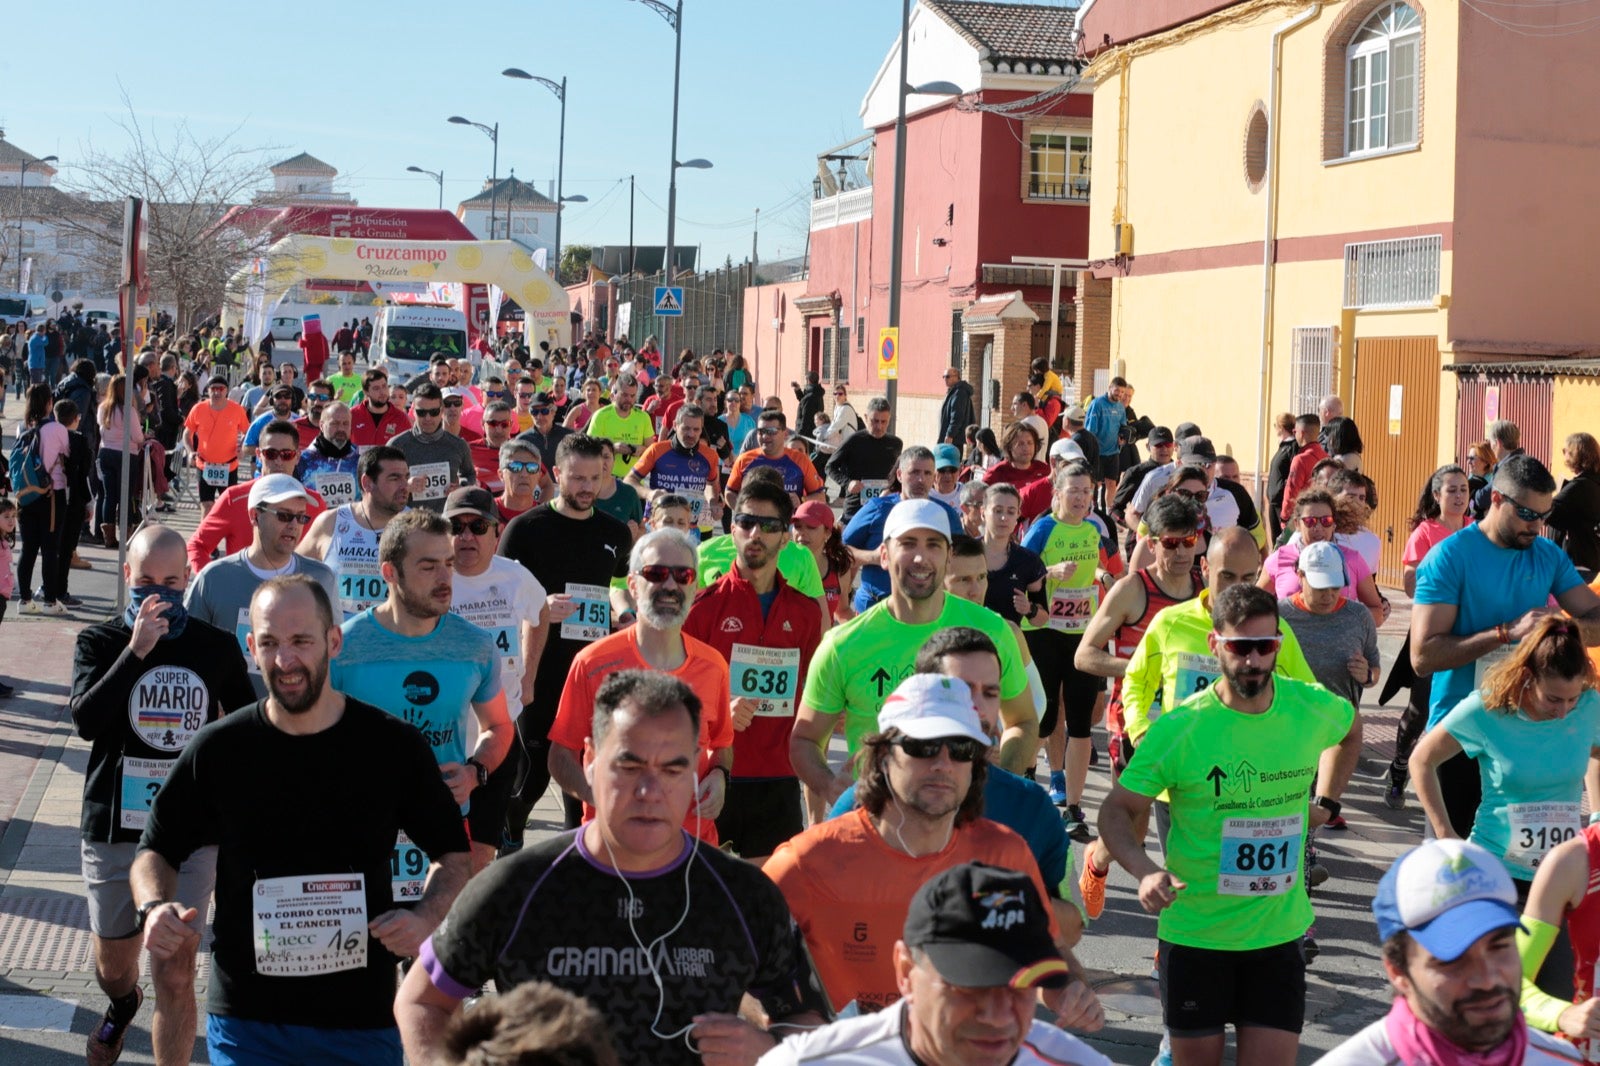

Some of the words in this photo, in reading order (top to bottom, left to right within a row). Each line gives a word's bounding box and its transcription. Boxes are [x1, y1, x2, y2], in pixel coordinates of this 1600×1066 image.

[354, 215, 407, 227] Diputación
[354, 228, 365, 237] de
[367, 228, 407, 239] Granada
[356, 244, 447, 263] Cruzcampo
[365, 264, 408, 278] Radler
[208, 469, 225, 479] 895
[321, 483, 352, 496] 3048
[460, 598, 508, 612] MARATÓN
[1053, 601, 1090, 617] 2242
[578, 602, 605, 625] 155
[155, 671, 189, 684] SUPER
[742, 668, 788, 695] 638
[139, 684, 204, 711] MARIO
[184, 711, 201, 731] 85
[143, 761, 157, 769] GRAN
[1260, 766, 1314, 783] Bioutsourcing
[1214, 799, 1247, 811] Consultores
[1248, 798, 1255, 808] de
[1256, 794, 1283, 808] Comercio
[1246, 821, 1261, 829] GRAN
[1262, 819, 1279, 828] PREMIO
[1252, 829, 1282, 838] DIPUTACIÓN
[1520, 826, 1575, 850] 3190
[1236, 841, 1289, 871] 861
[307, 882, 351, 892] Cruzcampo
[258, 912, 272, 921] YO
[275, 910, 314, 920] CORRO
[316, 906, 363, 917] CONTRA
[280, 921, 294, 930] EL
[296, 918, 342, 929] CANCER
[277, 934, 317, 947] aecc
[327, 928, 361, 951] 16
[547, 938, 676, 977] GRANADA
[673, 947, 715, 964] URBAN
[676, 961, 708, 977] TRAIL
